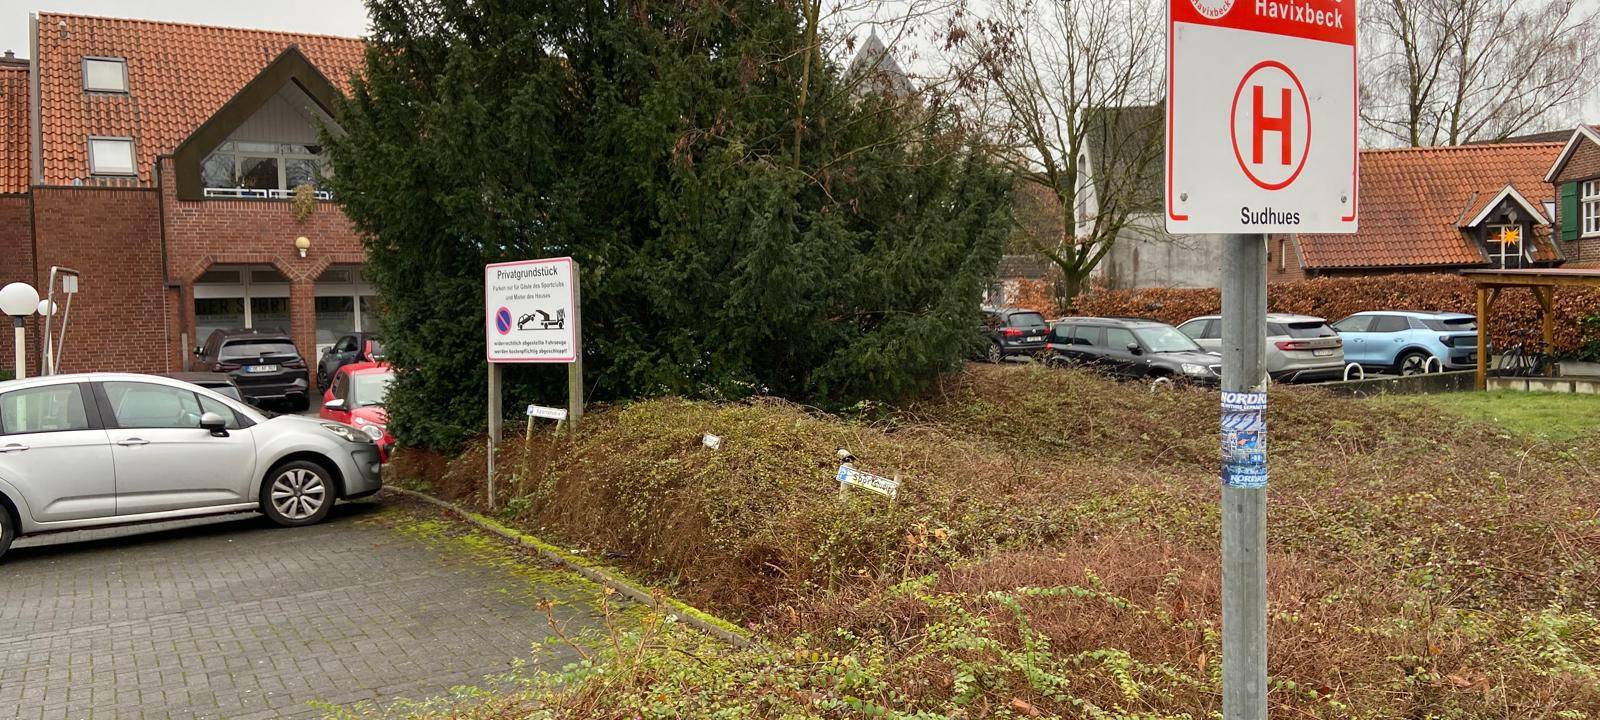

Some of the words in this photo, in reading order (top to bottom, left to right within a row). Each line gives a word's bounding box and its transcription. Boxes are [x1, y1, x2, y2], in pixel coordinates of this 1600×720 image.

[1255, 0, 1343, 29] Havixbeck
[1253, 85, 1292, 166] H
[1240, 206, 1300, 226] Sudhues
[497, 265, 558, 280] Privatgrundstück
